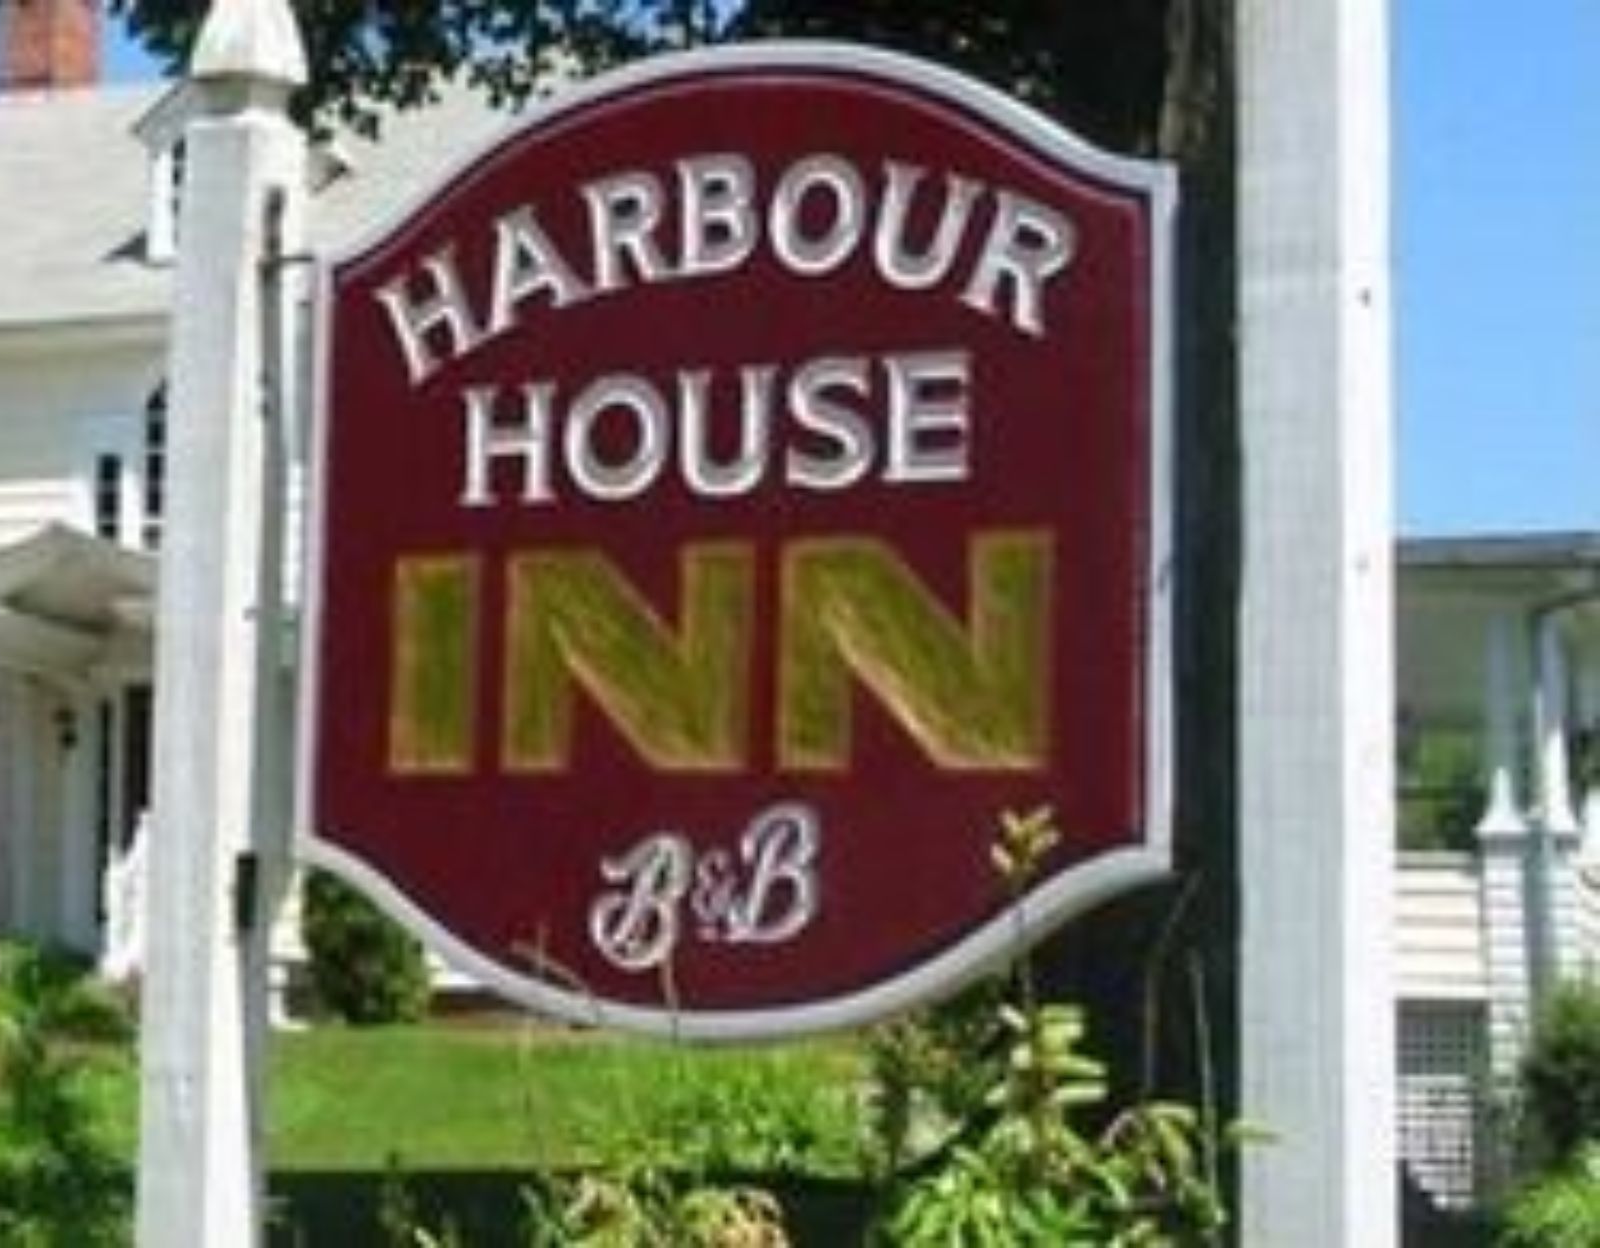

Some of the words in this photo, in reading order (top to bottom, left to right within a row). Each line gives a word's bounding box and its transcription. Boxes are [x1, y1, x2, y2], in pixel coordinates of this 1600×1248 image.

[373, 152, 1078, 385] HARBOUR
[458, 350, 974, 508] HOUSE
[388, 527, 1058, 776] INN
[590, 805, 819, 970] B&B
